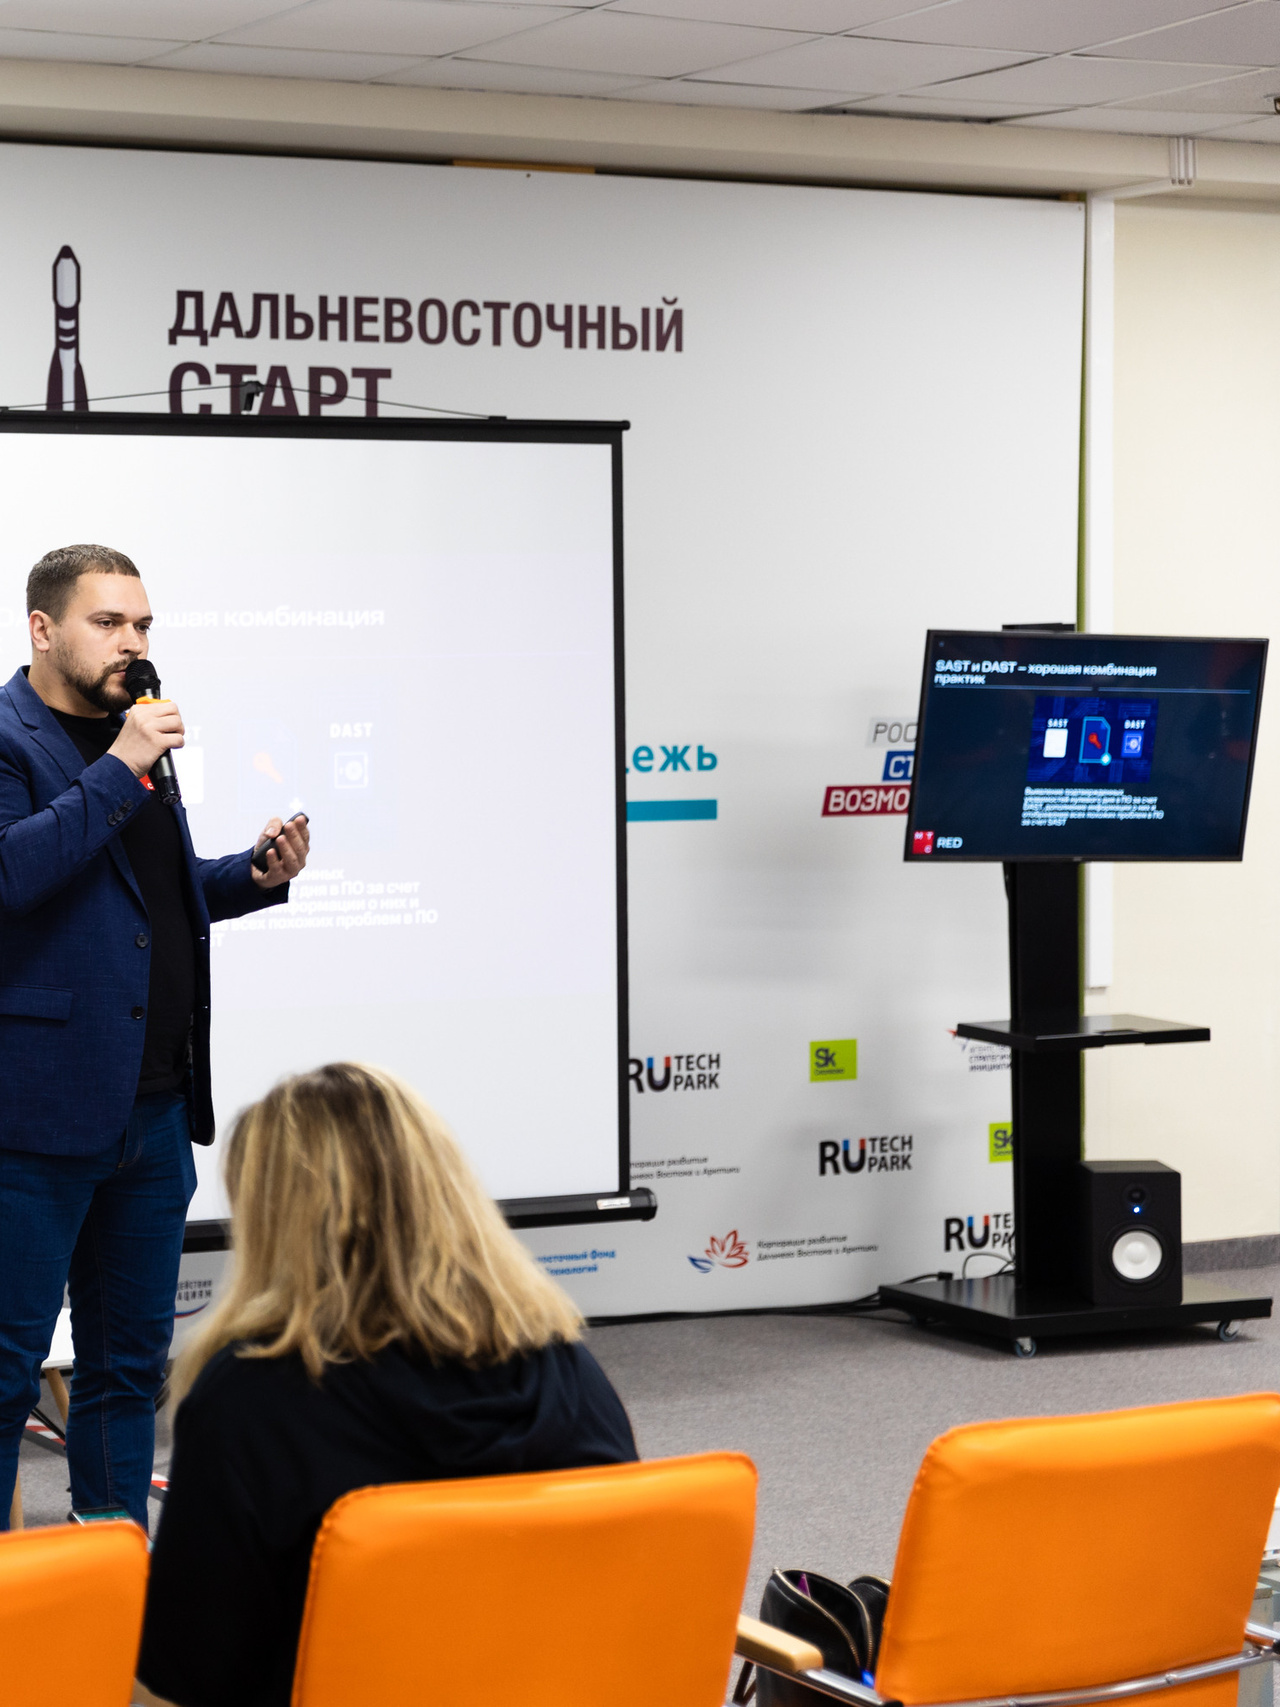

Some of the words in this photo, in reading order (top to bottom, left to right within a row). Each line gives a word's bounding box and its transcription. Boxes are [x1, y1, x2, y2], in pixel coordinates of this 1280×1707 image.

[168, 289, 683, 353] ДАЛЬНЕВОСТОЧНЫЙ
[168, 362, 392, 417] СТАРТ
[223, 605, 385, 632] комбинация
[935, 660, 971, 672] SAST
[971, 662, 980, 672] и
[981, 661, 1017, 673] DAST
[1028, 664, 1082, 677] хорошая
[1083, 663, 1157, 678] комбинация
[934, 673, 985, 685] практик
[329, 721, 373, 738] DAST
[1047, 718, 1069, 728] SAST
[625, 744, 718, 774] ежь
[937, 836, 963, 849] RED
[674, 1053, 721, 1071] TECH
[673, 1073, 720, 1091] PARK
[819, 1138, 866, 1176] RU
[869, 1134, 913, 1153] TECH
[868, 1154, 912, 1173] PARK
[944, 1214, 990, 1253] RU
